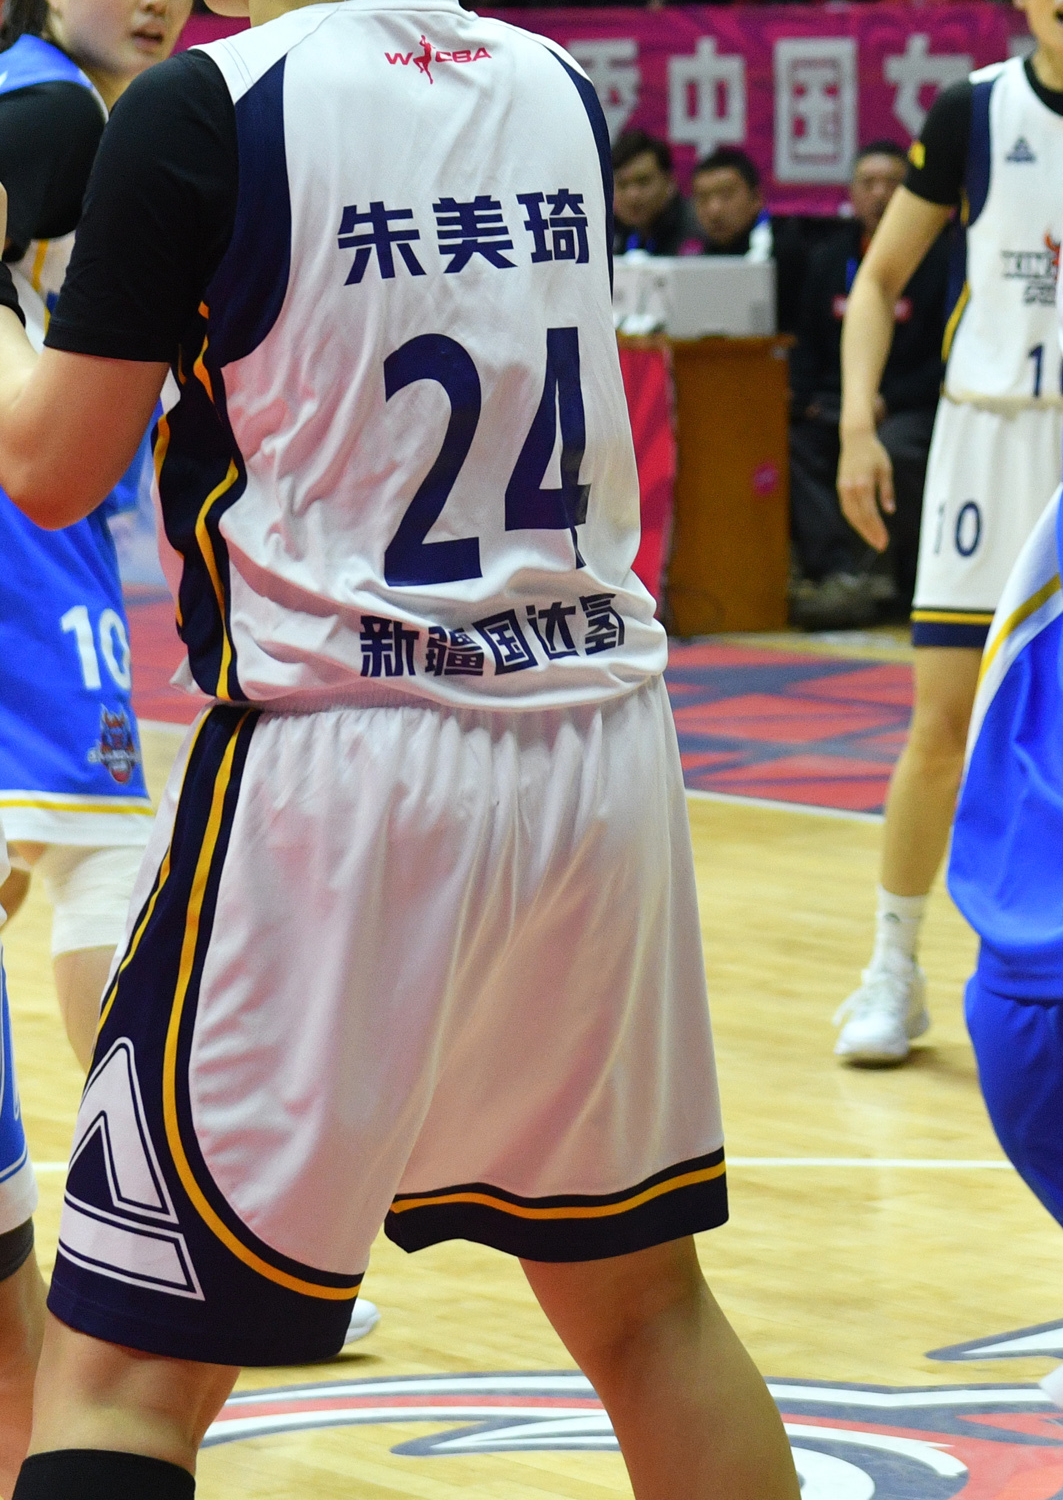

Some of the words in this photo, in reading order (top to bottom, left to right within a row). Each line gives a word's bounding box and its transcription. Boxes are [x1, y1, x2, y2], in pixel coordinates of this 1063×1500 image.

[384, 47, 493, 67] WCBA
[337, 188, 591, 287] 朱美琦
[383, 326, 592, 588] 24
[60, 604, 131, 690] 10
[359, 592, 626, 678] 新疆国达氢
